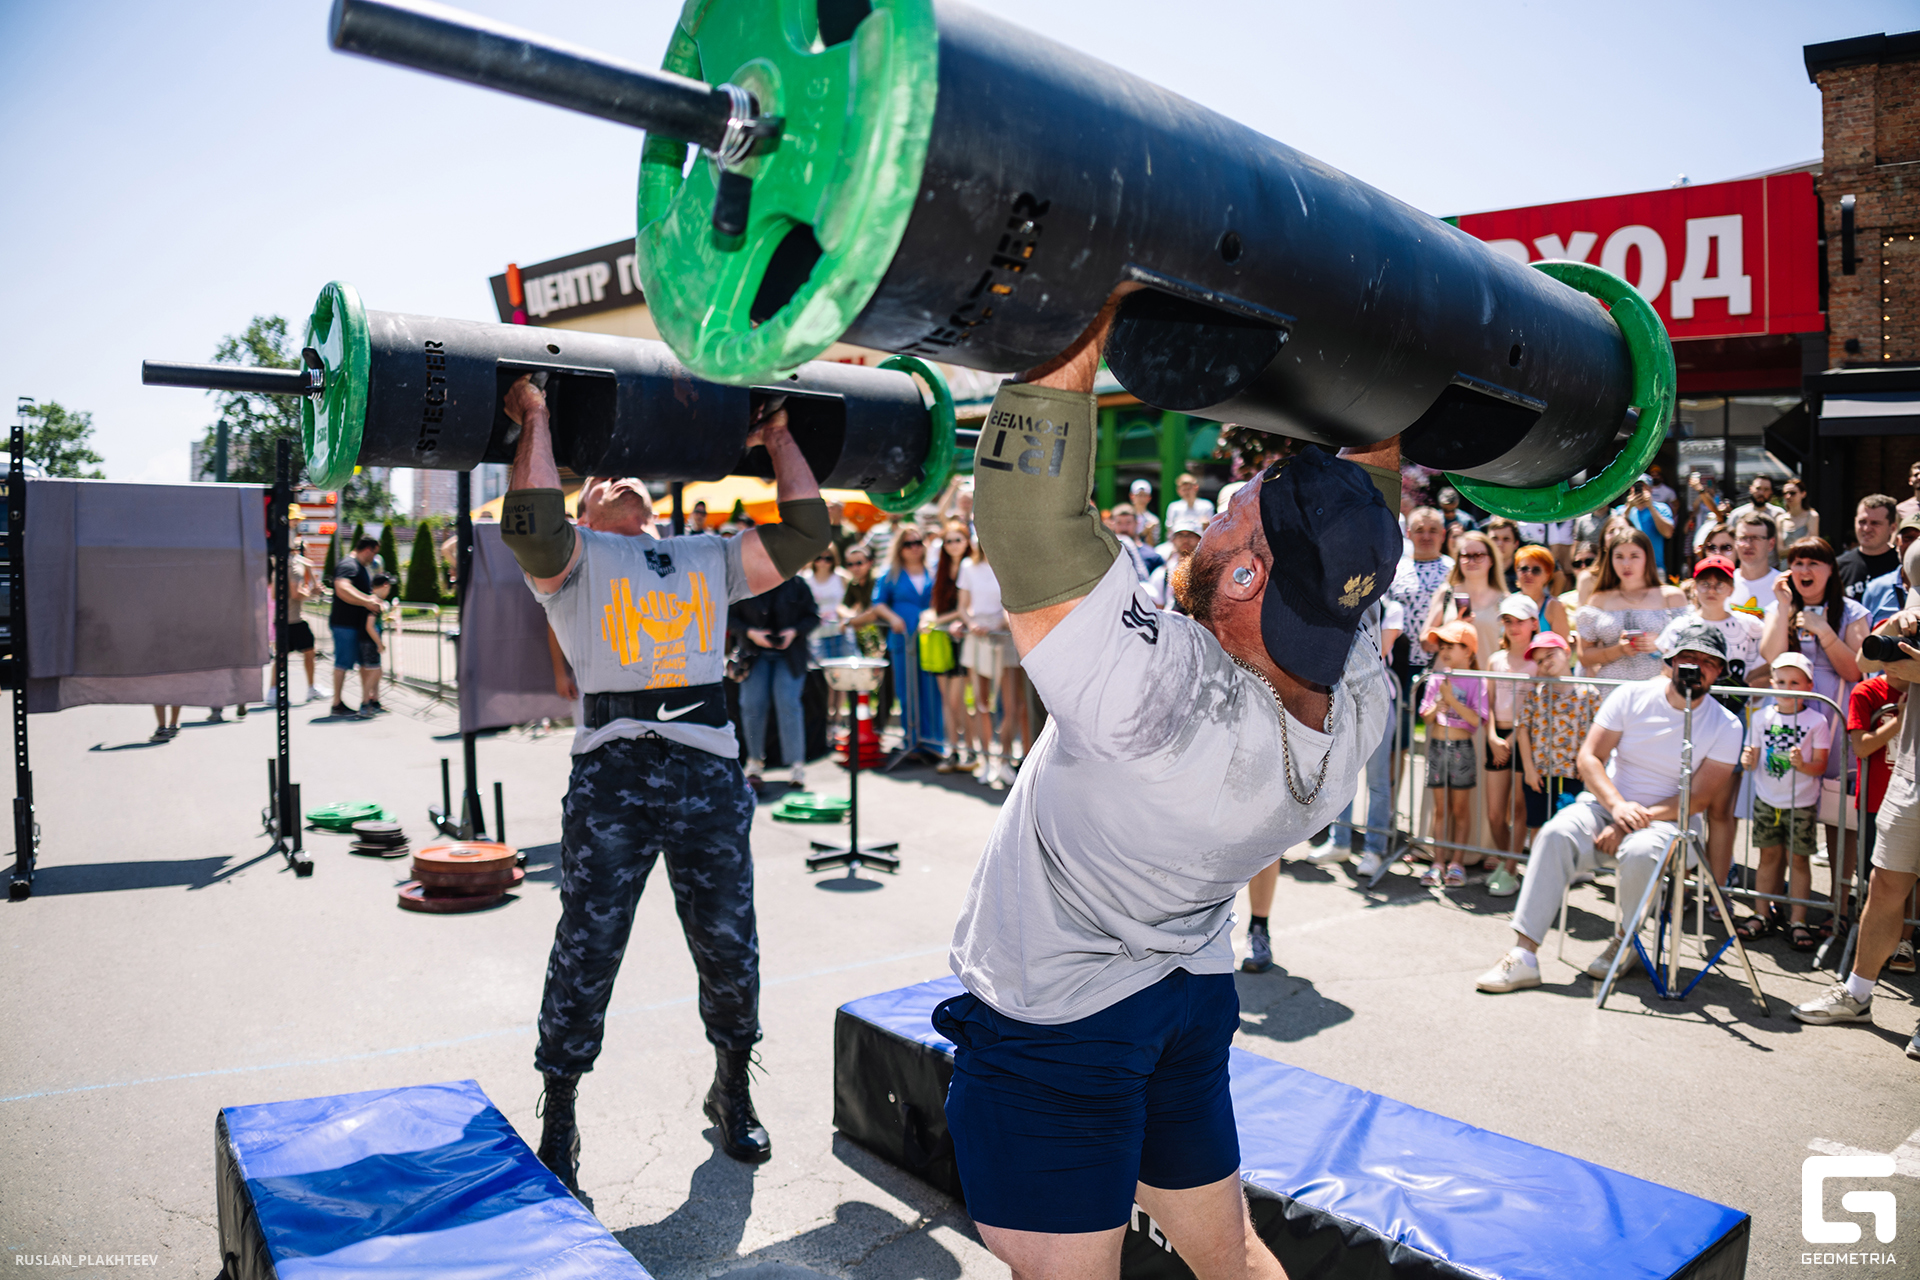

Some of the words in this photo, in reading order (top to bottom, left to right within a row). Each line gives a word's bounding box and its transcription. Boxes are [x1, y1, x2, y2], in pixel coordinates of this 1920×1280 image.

[524, 262, 611, 318] ЦЕНТР
[899, 190, 1051, 356] TECTER
[1488, 214, 1752, 320] ОД
[416, 340, 446, 452] STECTER
[990, 410, 1069, 437] POWER
[980, 430, 1066, 477] RT
